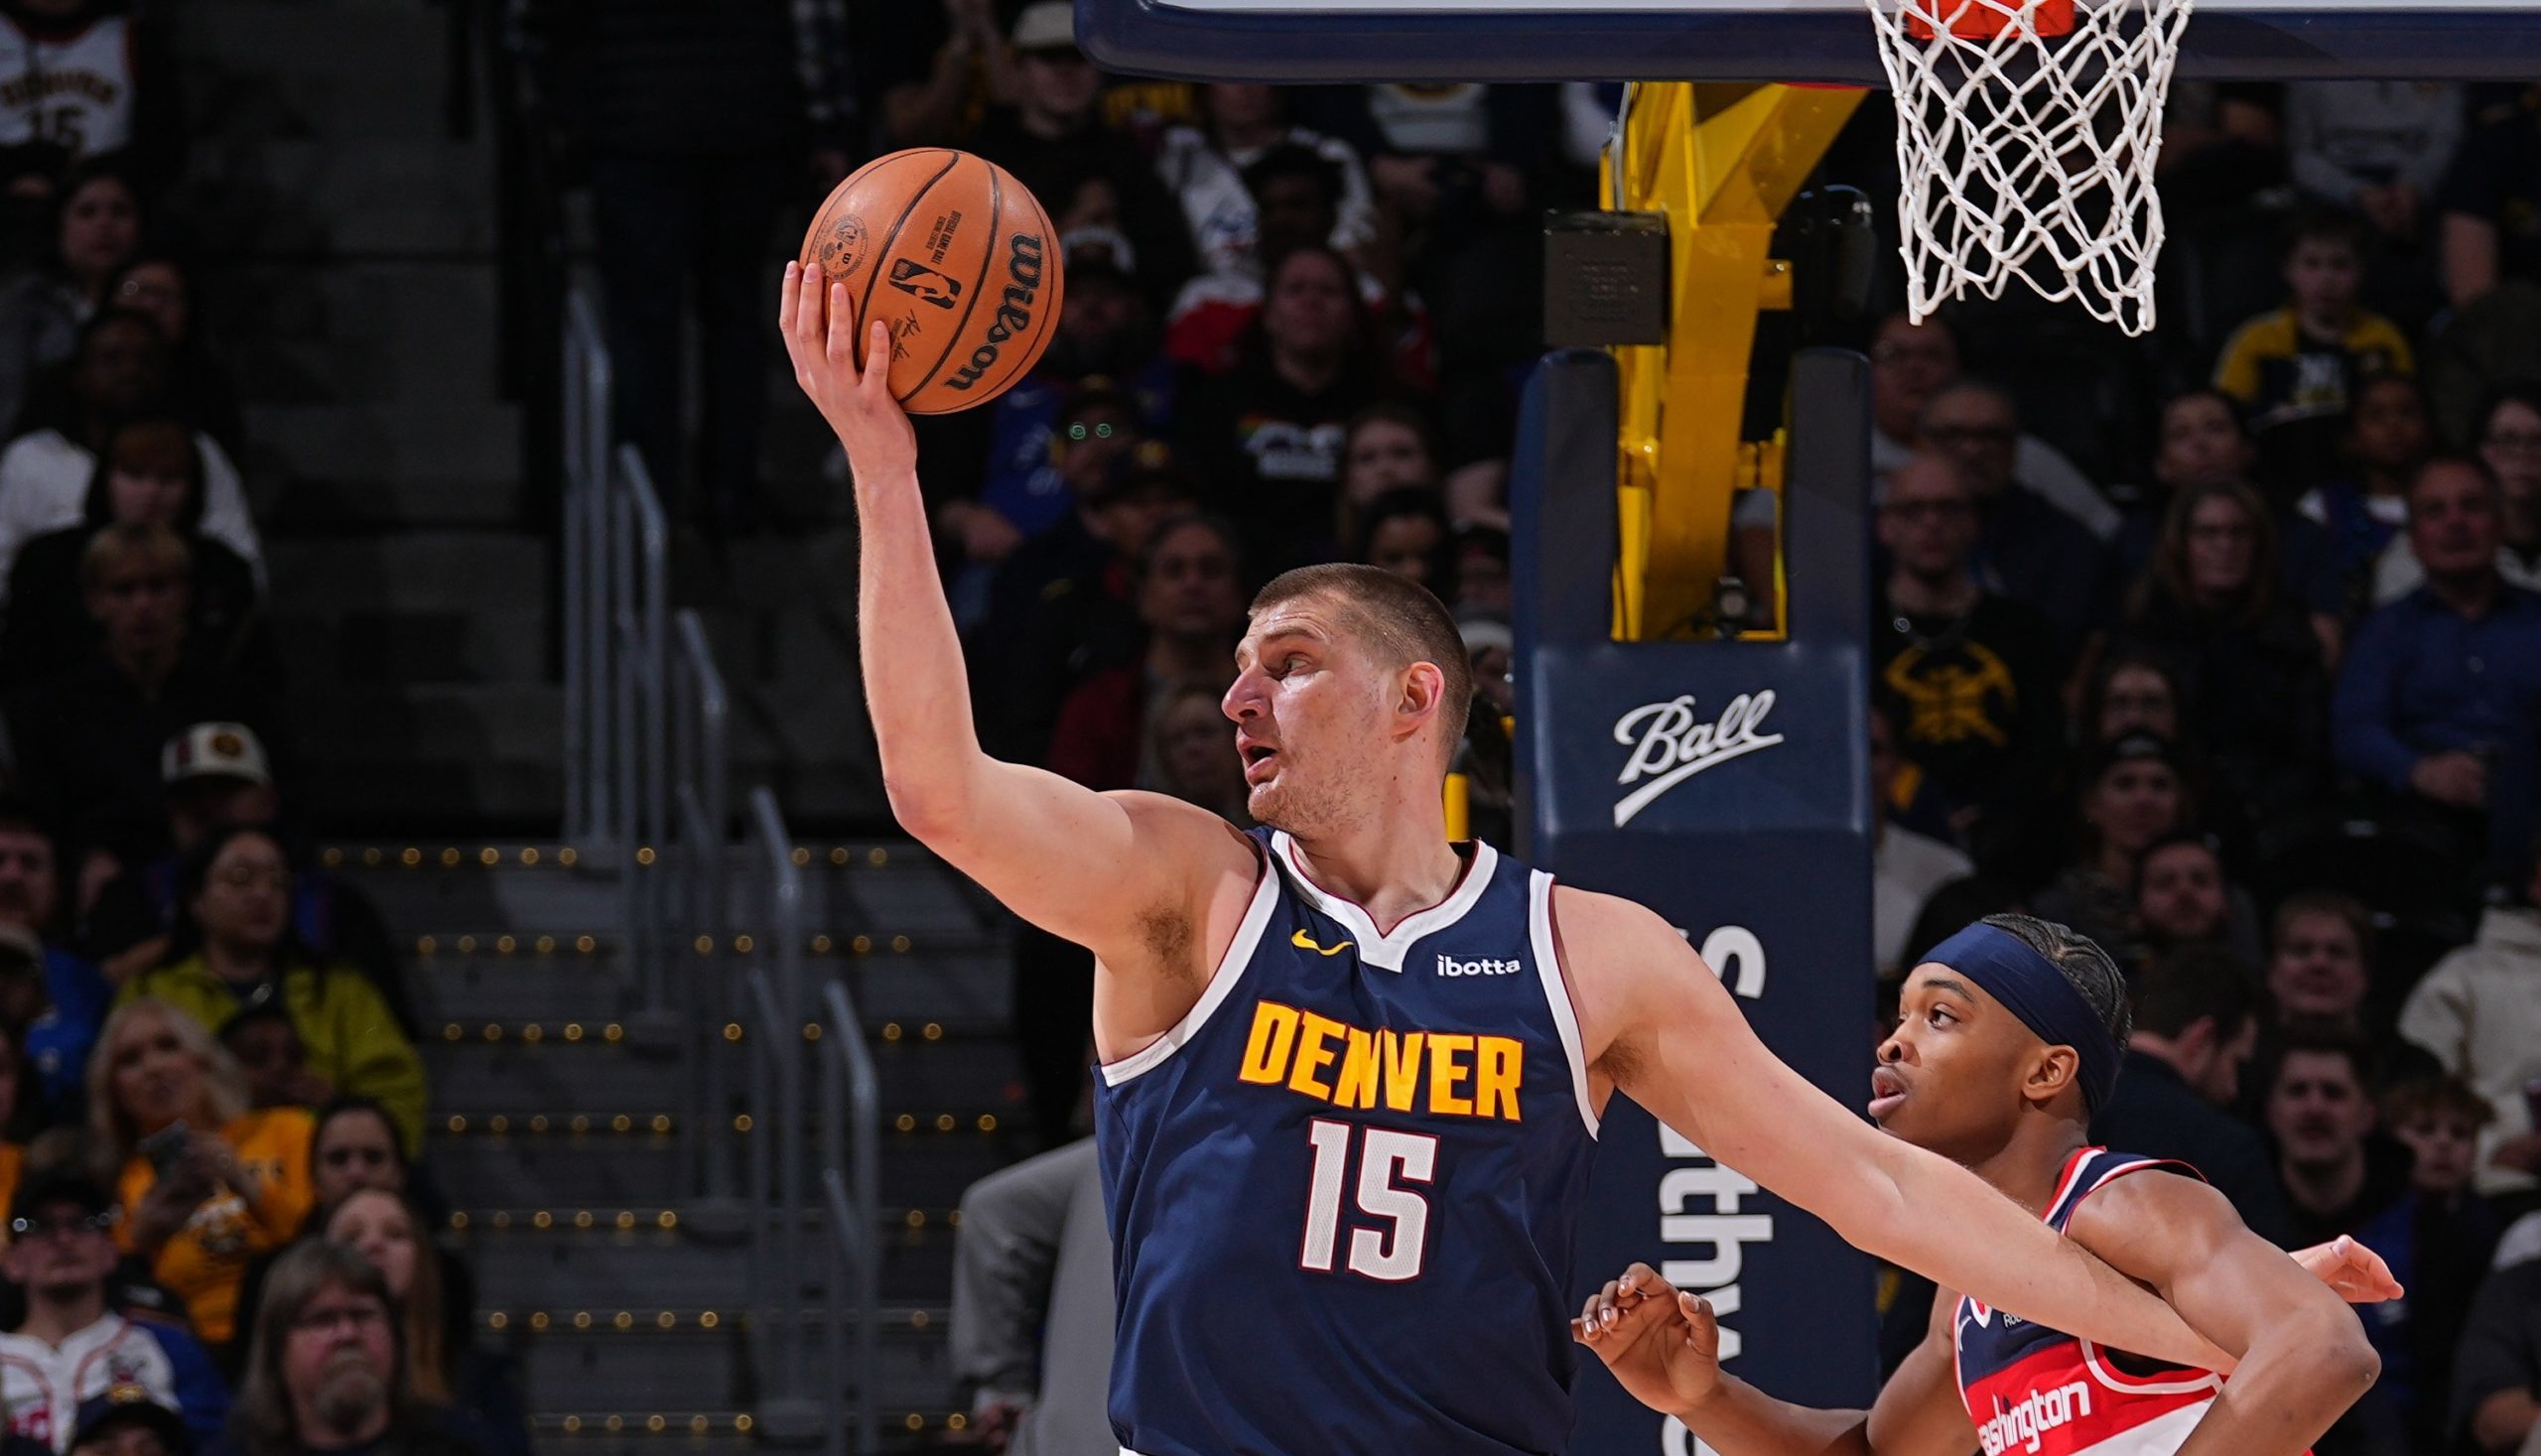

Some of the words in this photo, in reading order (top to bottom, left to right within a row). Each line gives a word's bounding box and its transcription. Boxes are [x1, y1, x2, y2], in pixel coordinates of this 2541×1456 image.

[946, 232, 1043, 391] Wilson
[1613, 689, 1785, 784] Ball
[1436, 955, 1521, 977] ibotta
[1238, 999, 1524, 1124] DENVER
[1298, 1116, 1440, 1281] 15
